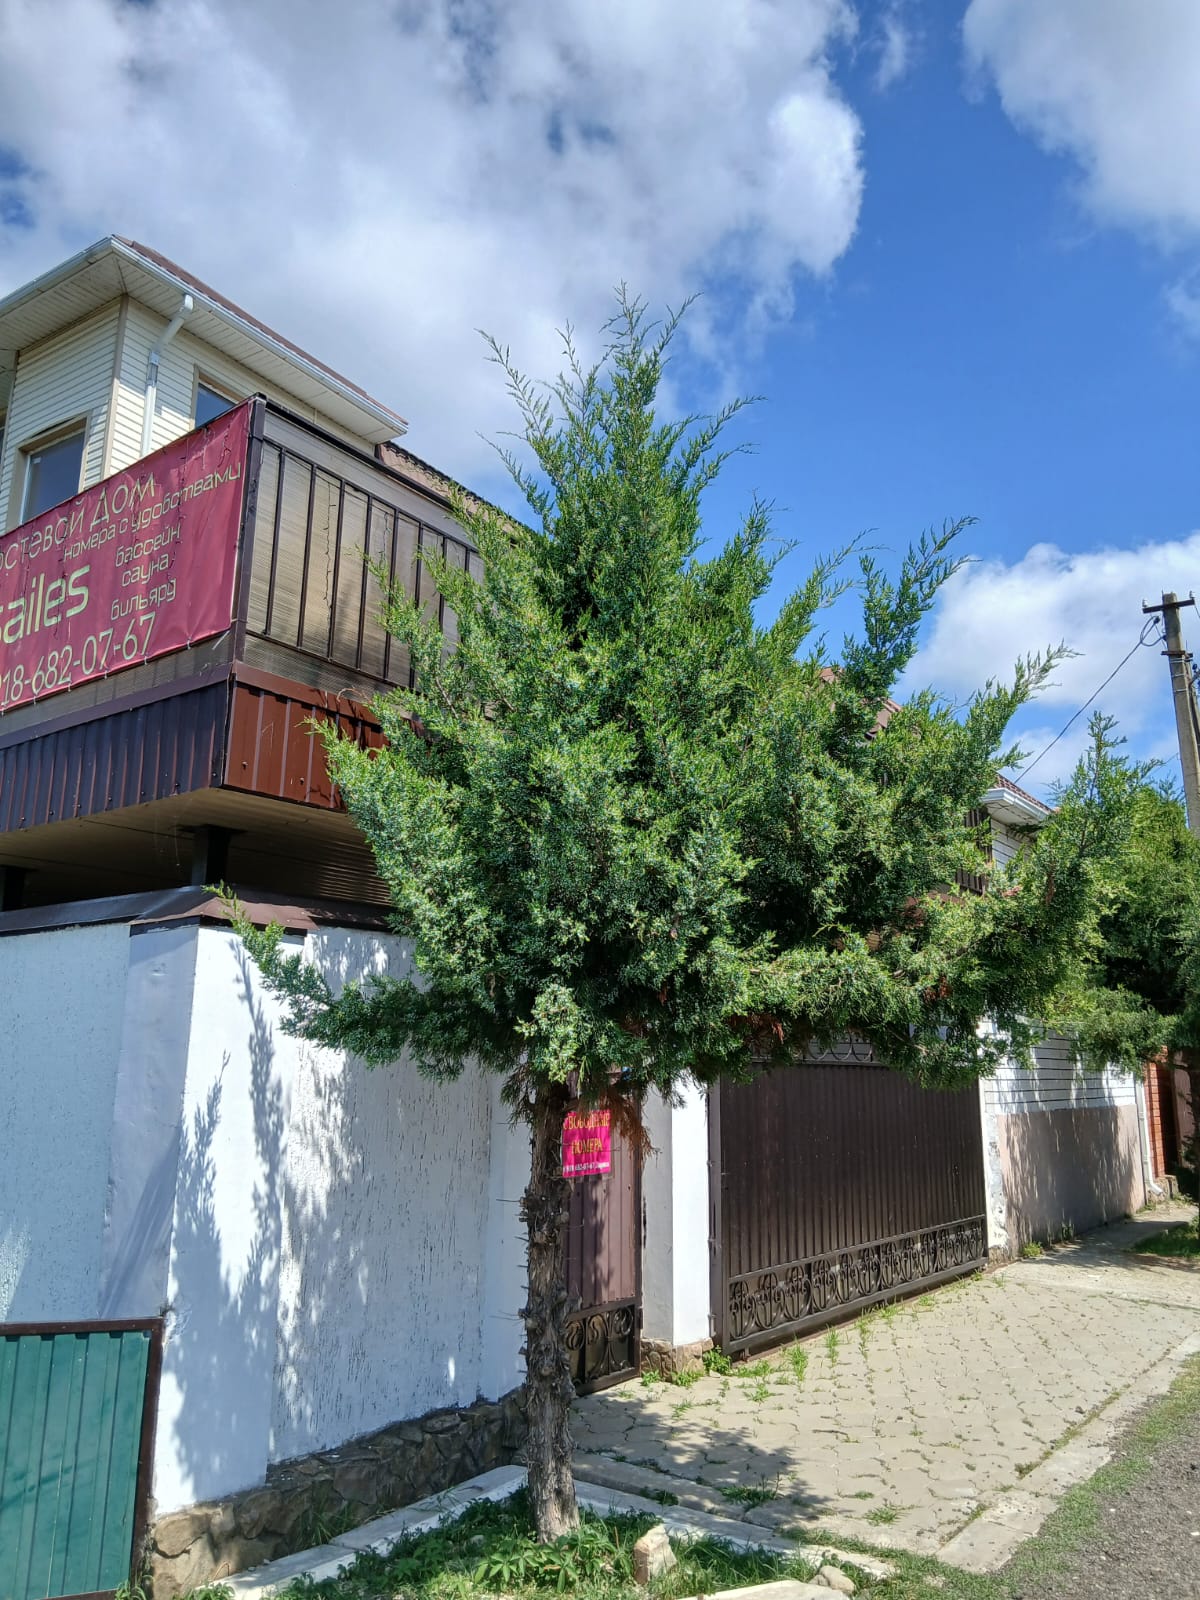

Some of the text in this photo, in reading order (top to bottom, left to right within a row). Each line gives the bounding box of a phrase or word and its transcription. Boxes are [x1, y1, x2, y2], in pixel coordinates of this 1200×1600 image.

[63, 462, 241, 562] номера с удобствами
[90, 472, 155, 532] ДОМ
[115, 522, 180, 567] бассейн
[122, 553, 169, 586] сауна
[0, 565, 90, 644] ailes
[0, 611, 155, 706] 18-682-07-67
